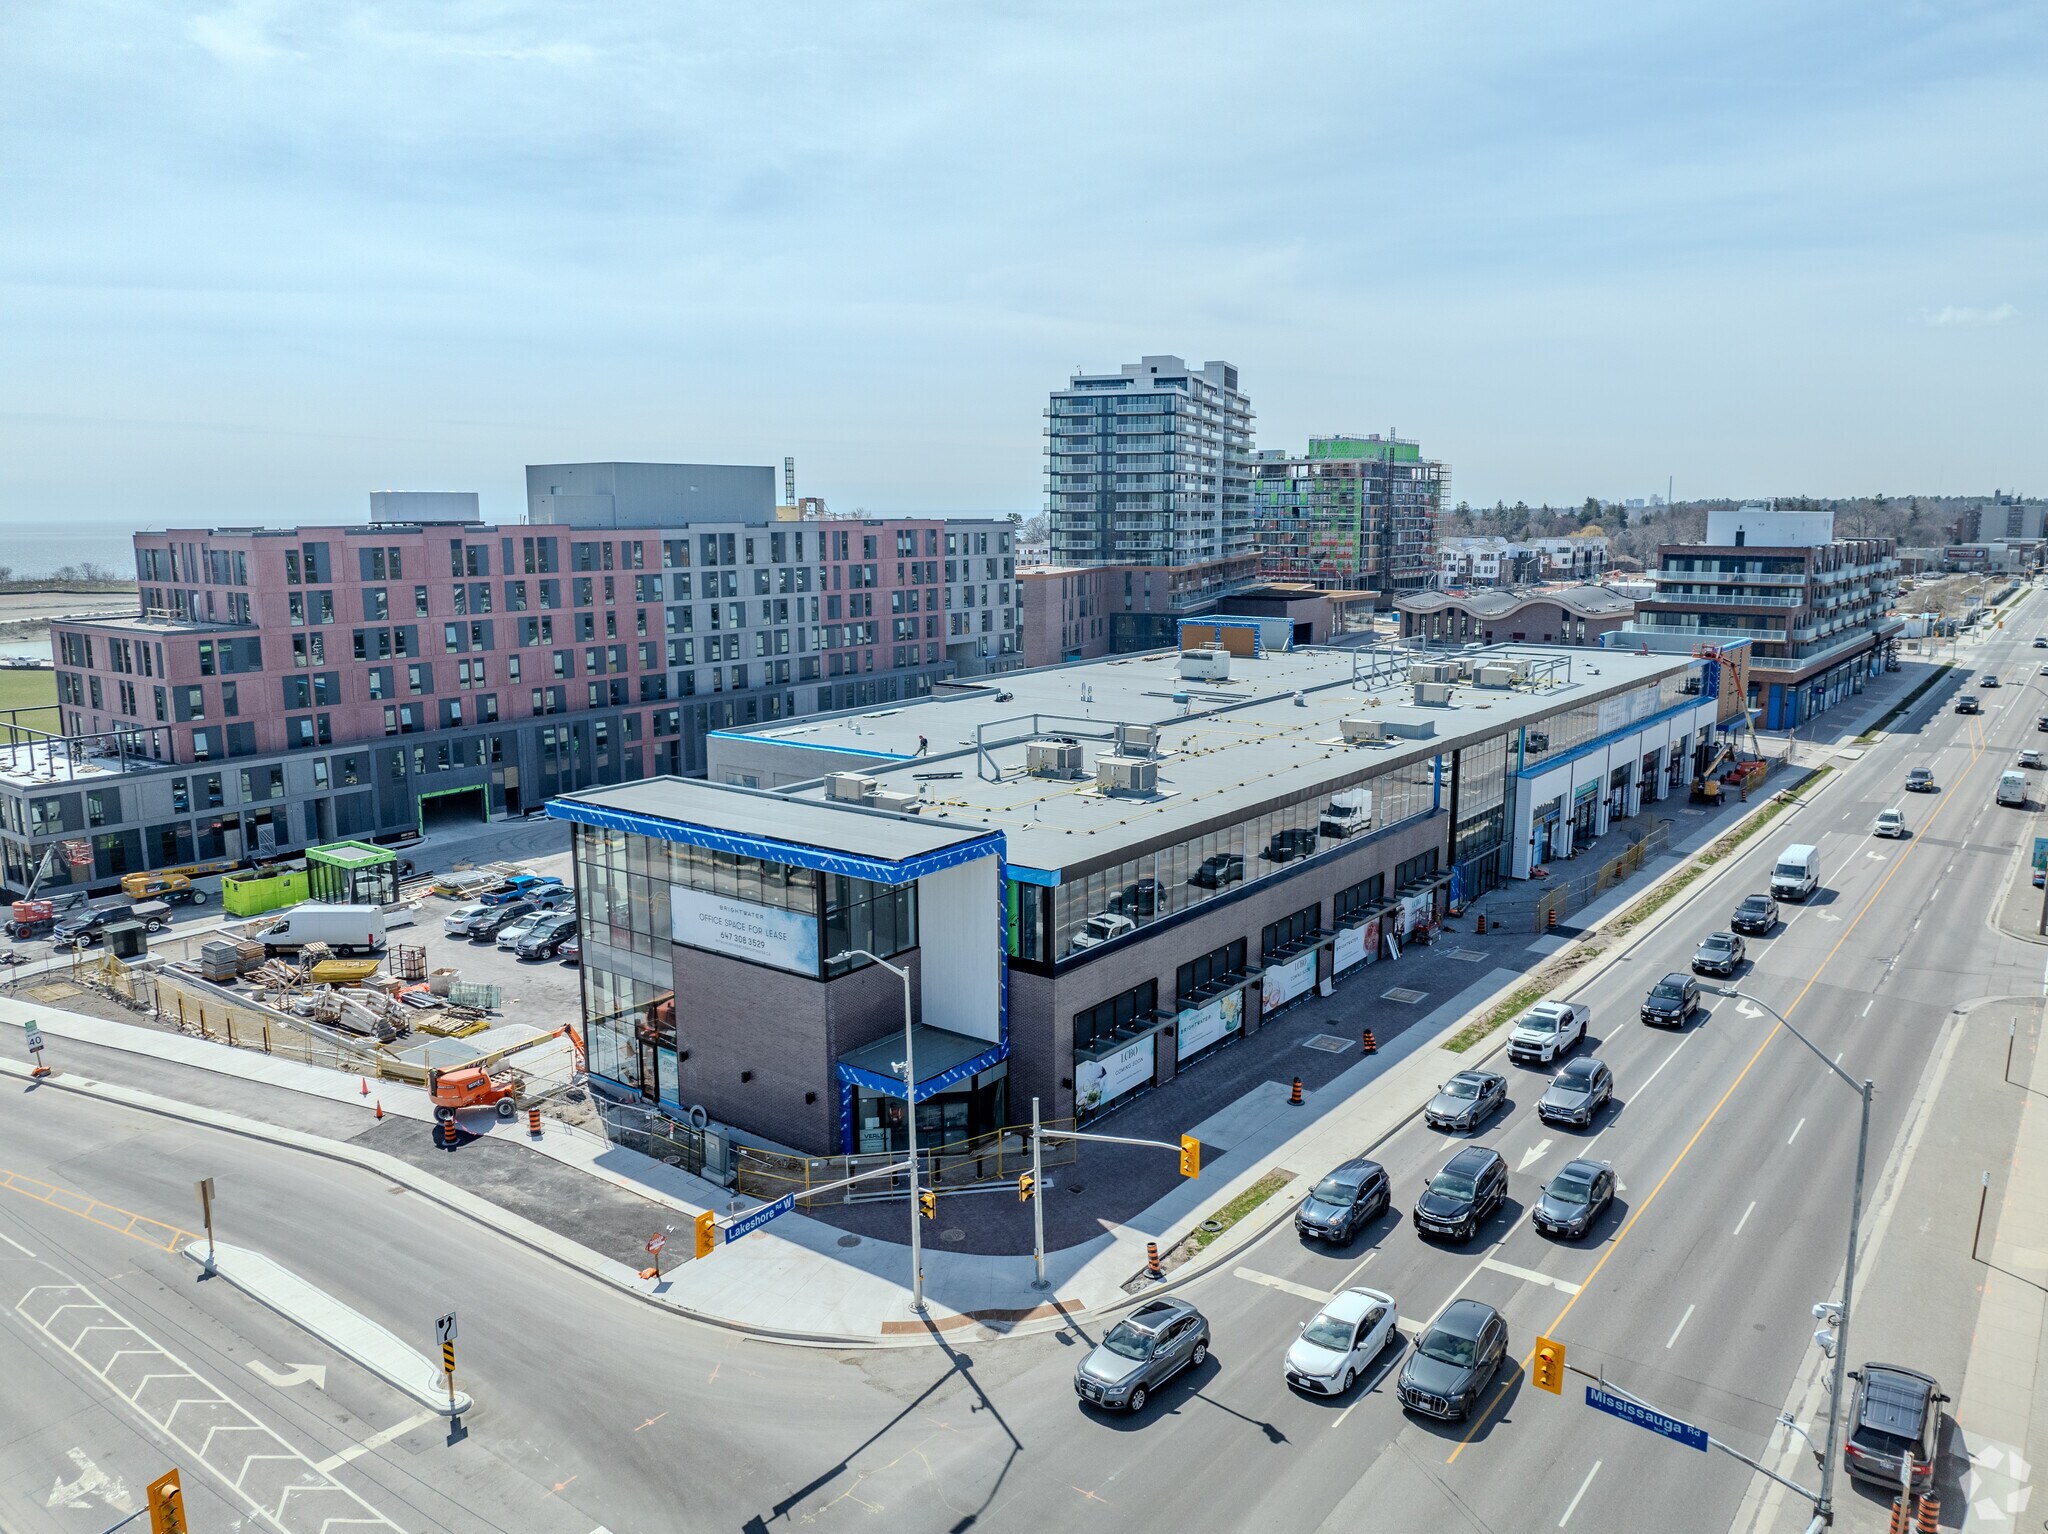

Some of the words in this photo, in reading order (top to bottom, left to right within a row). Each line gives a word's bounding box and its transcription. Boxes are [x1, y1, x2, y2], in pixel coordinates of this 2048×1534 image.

[719, 905, 764, 919] BRIGHTWATER
[699, 913, 722, 926] OFFICE
[724, 919, 746, 931] SPACE
[748, 924, 763, 936] FOR
[765, 929, 787, 941] LEASE
[720, 931, 733, 940] 647
[733, 934, 747, 945] 308
[747, 937, 765, 949] 3529
[1180, 1014, 1212, 1035] BRIGHTWATER
[29, 1036, 42, 1046] 40
[1120, 1046, 1139, 1063] LCBO
[1114, 1063, 1132, 1077] COMING
[1132, 1057, 1144, 1067] SOON
[728, 1208, 775, 1240] Lakeshore
[775, 1203, 782, 1211] Rd
[783, 1197, 792, 1209] W
[1590, 1388, 1682, 1434] Mississauga
[1687, 1426, 1701, 1437] Rd
